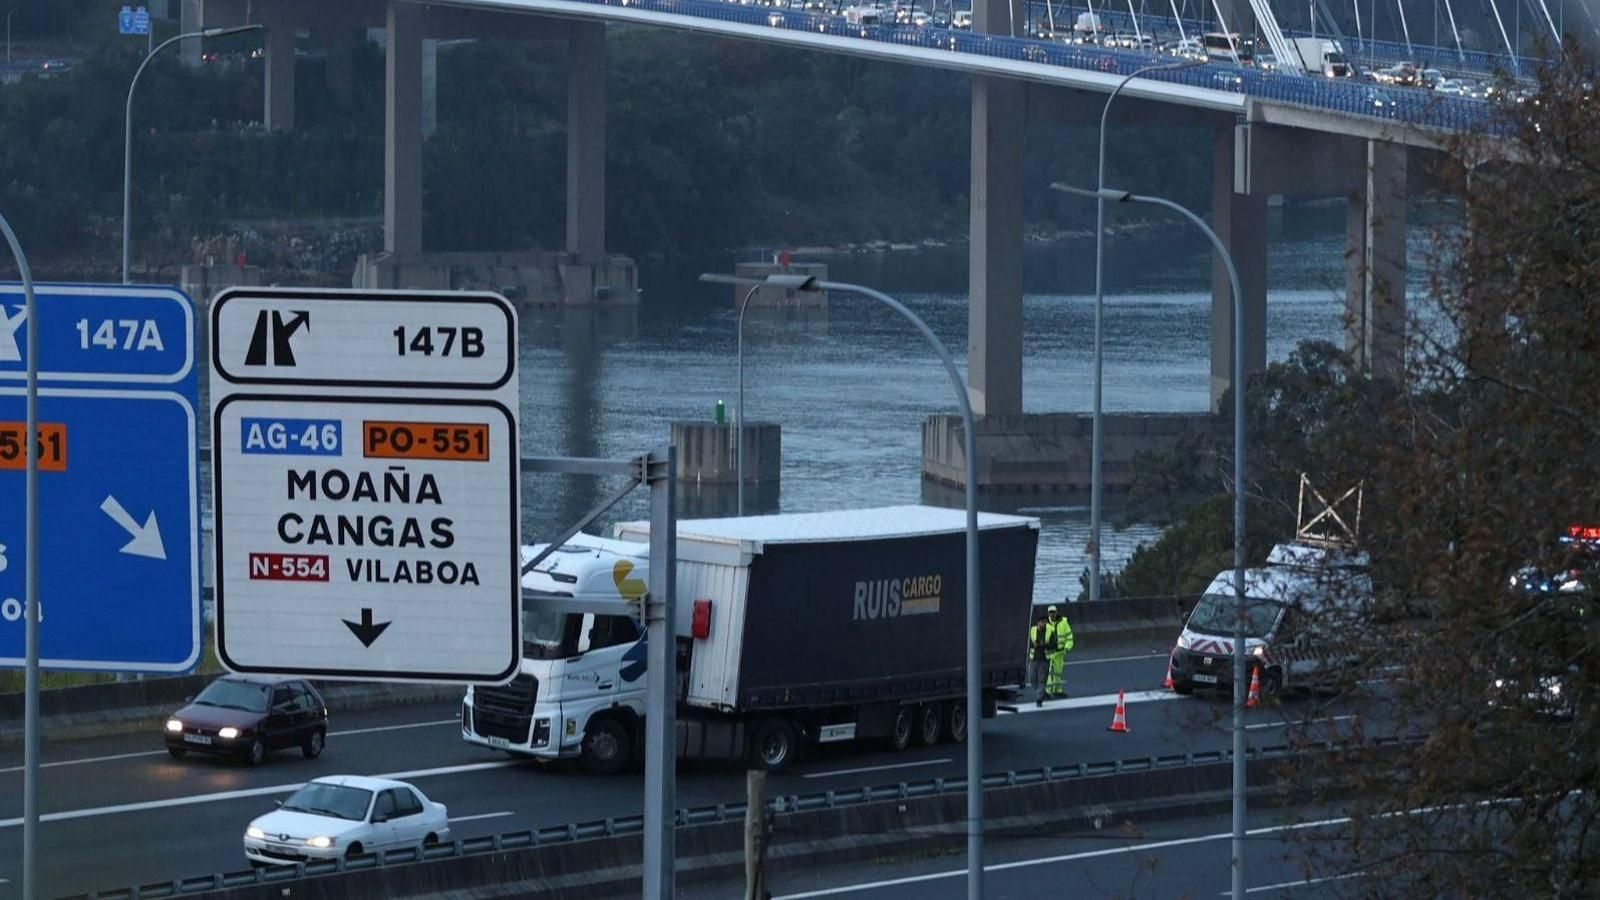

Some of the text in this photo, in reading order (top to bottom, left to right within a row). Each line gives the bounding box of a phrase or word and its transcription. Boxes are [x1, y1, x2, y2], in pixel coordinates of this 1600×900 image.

[76, 318, 164, 351] 147A
[393, 325, 485, 358] 147B
[246, 422, 485, 456] AG-46 PO-551
[287, 465, 443, 505] MOAÑA
[277, 512, 455, 549] CANGAS
[251, 556, 480, 586] N-554 VILABOA
[853, 573, 942, 620] RUIS CARGO
